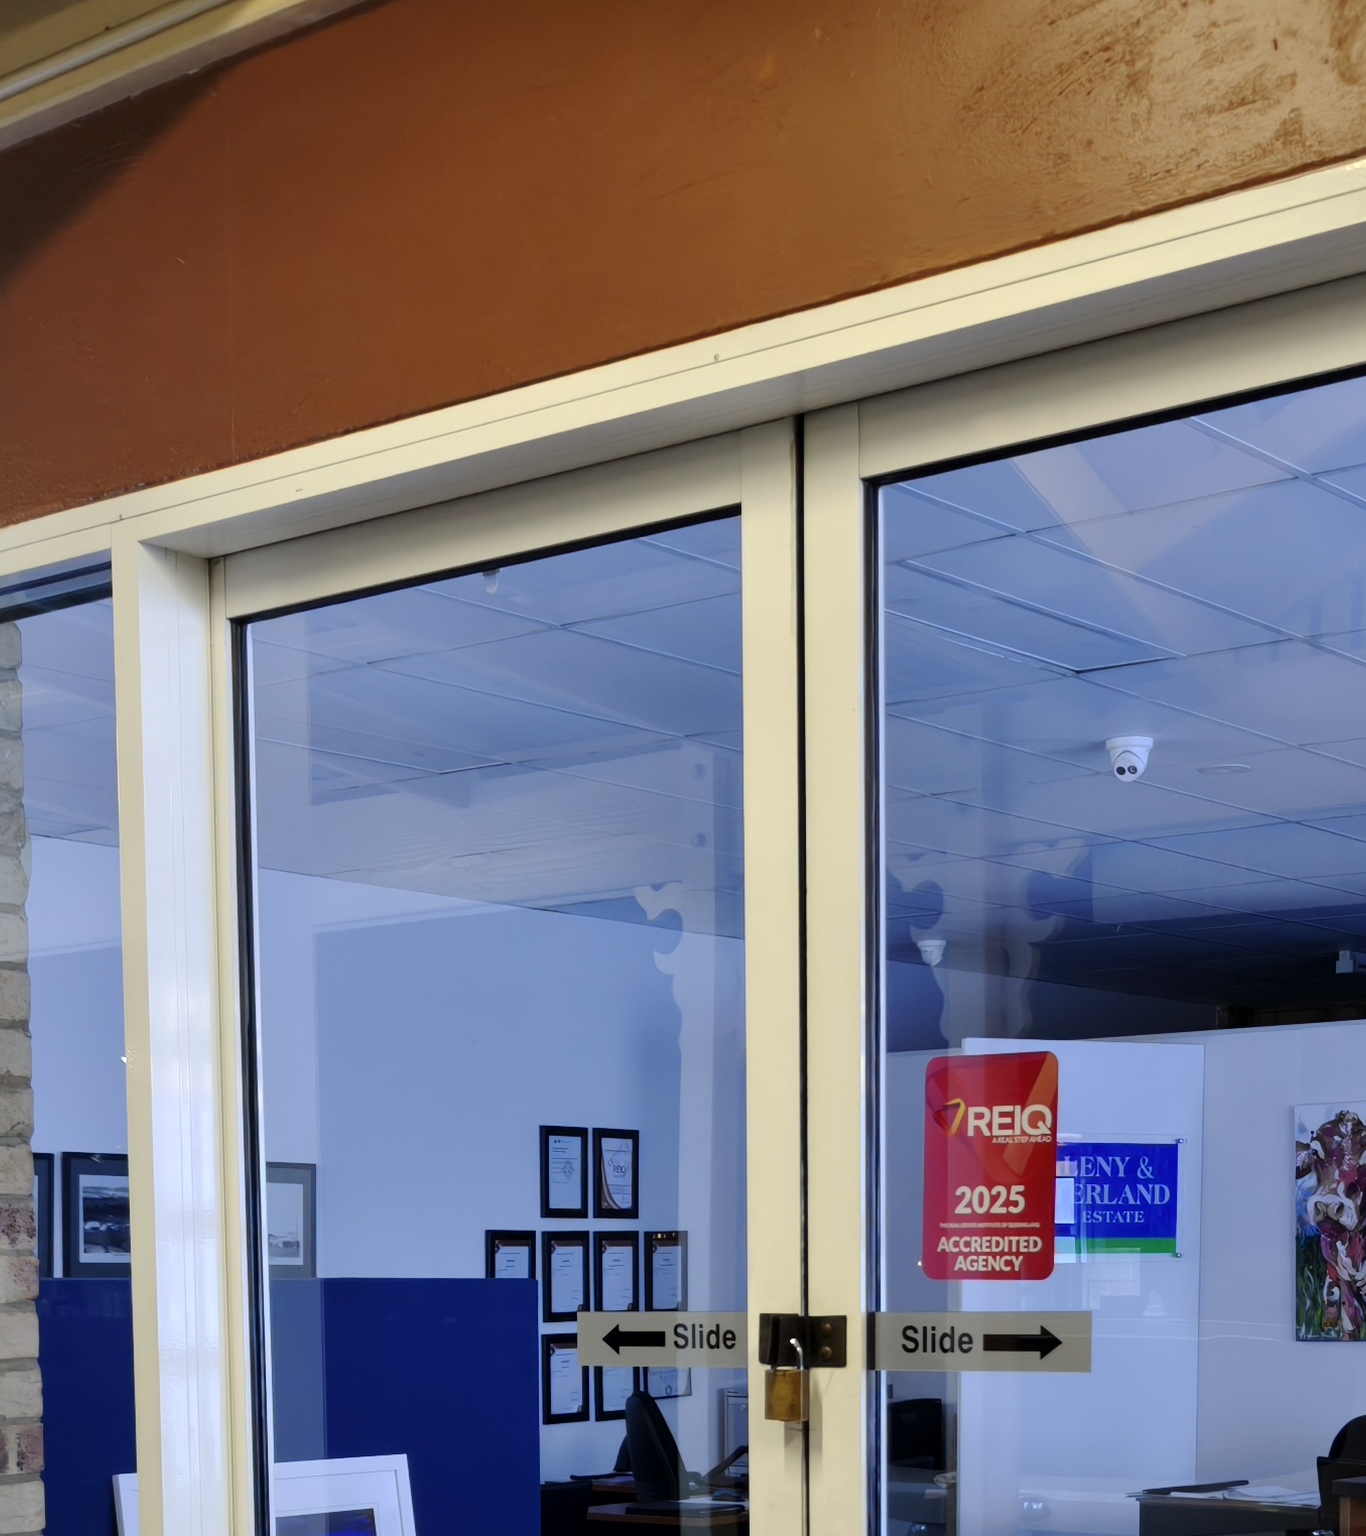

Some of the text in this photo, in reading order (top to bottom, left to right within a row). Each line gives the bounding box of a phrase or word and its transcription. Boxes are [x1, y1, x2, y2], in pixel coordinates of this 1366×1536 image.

[967, 1104, 1052, 1137] REIQ
[1137, 1156, 1154, 1179] &
[954, 1185, 1026, 1214] 2025
[1083, 1210, 1145, 1223] ESTATE
[936, 1236, 1042, 1253] ACCREDITED
[954, 1255, 1023, 1272] AGENCY
[672, 1323, 737, 1350] Slide
[901, 1325, 974, 1354] Slide
